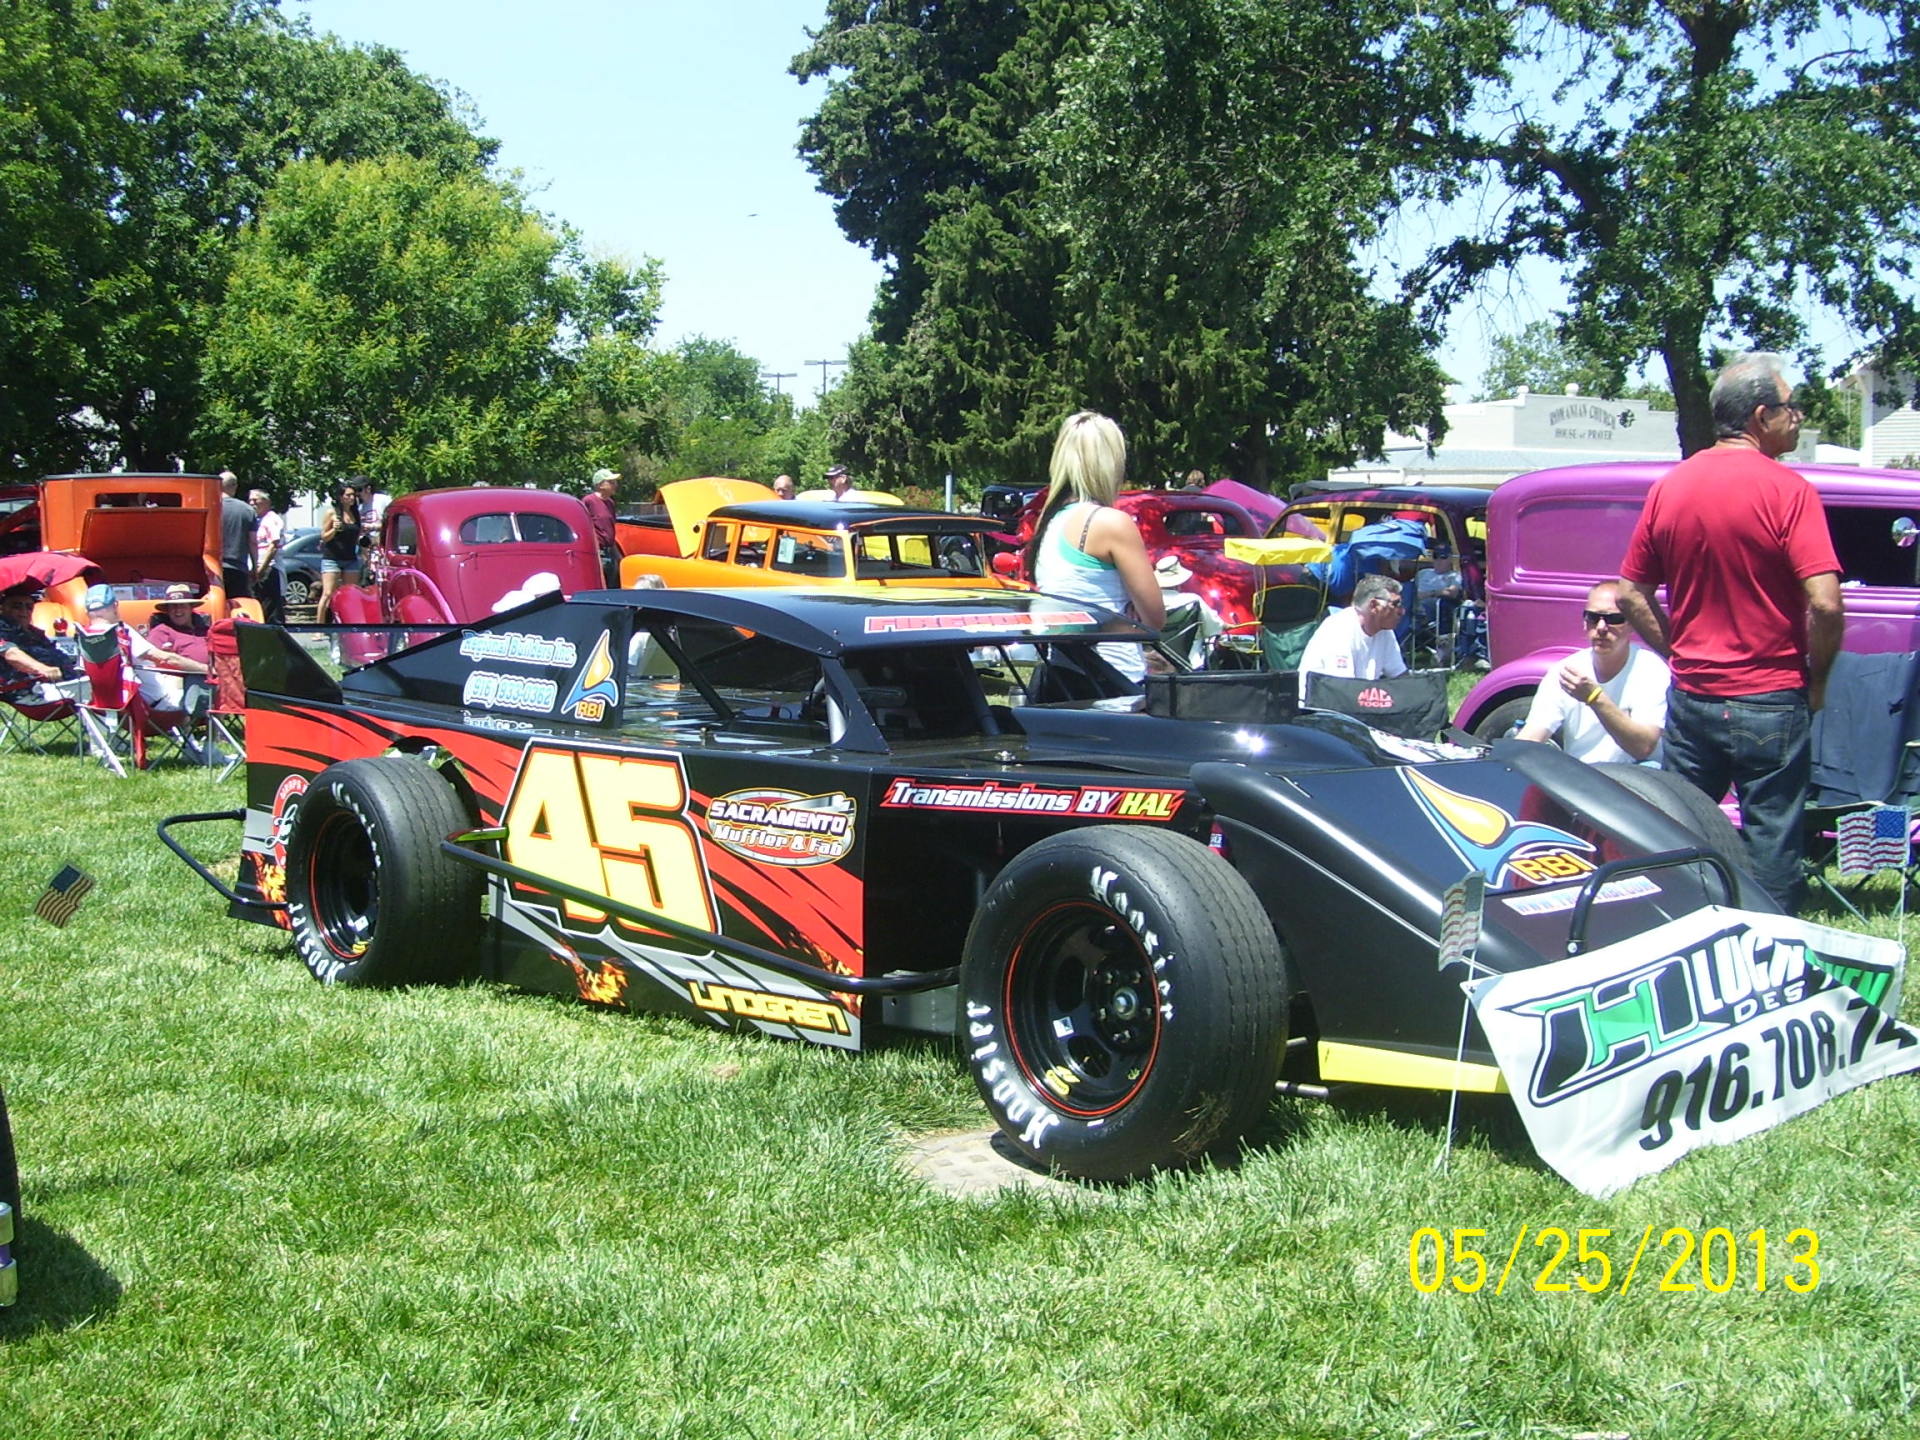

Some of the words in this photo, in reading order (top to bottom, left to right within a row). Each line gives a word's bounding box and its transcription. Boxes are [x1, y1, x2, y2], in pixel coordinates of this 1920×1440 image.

[1589, 405, 1617, 430] CHURCH
[1555, 428, 1577, 440] HOUSE
[1358, 687, 1392, 701] MAC
[1358, 700, 1393, 708] TOOLS
[576, 701, 605, 720] RBI
[891, 781, 1072, 813] Transmissions
[1076, 790, 1118, 814] BY
[1118, 791, 1177, 817] HAL
[709, 801, 848, 836] SACRAMENTO
[507, 747, 717, 939] 45
[713, 823, 788, 848] Muffler
[791, 834, 806, 851] &
[809, 837, 844, 857] Fab
[1509, 853, 1594, 881] RBI
